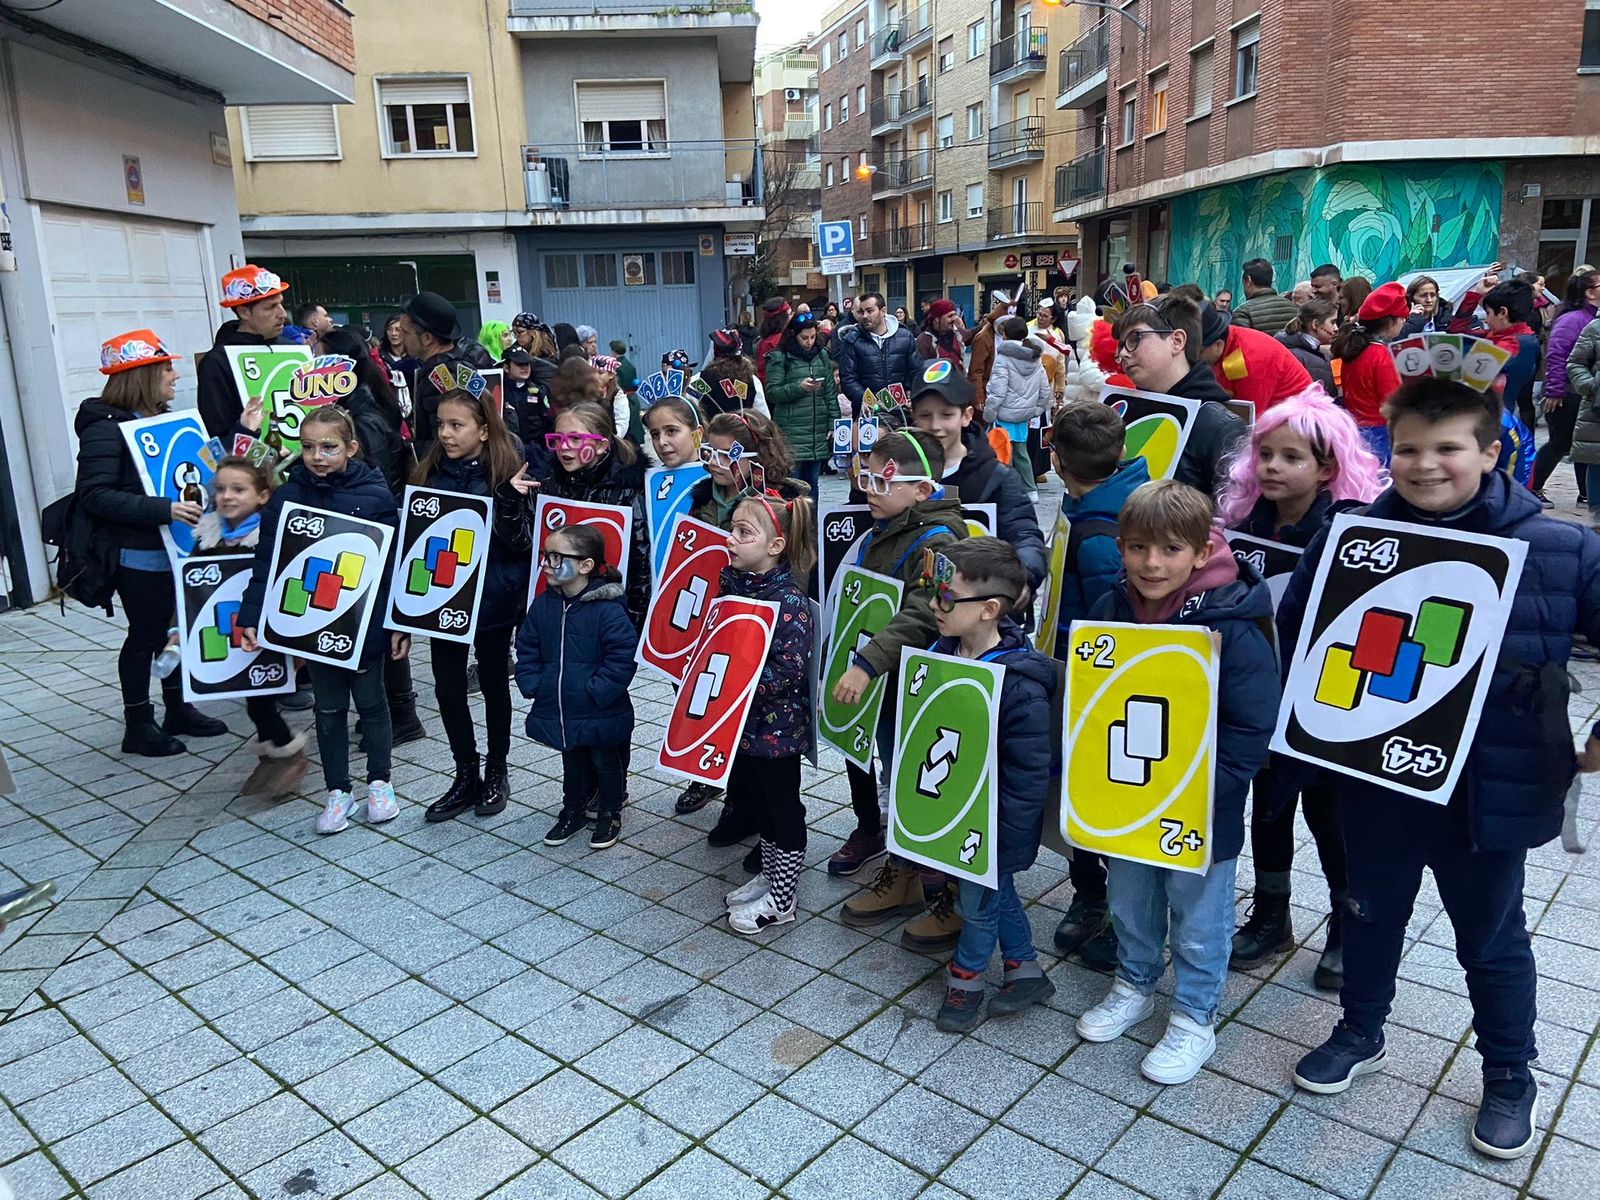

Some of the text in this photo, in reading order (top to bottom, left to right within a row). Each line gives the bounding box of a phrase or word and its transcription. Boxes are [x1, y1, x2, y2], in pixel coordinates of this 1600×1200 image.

[825, 225, 846, 253] P
[243, 356, 262, 381] 5
[289, 370, 358, 401] UNO
[140, 432, 161, 457] 8
[863, 427, 873, 440] 4
[413, 499, 438, 516] +4
[290, 518, 322, 537] +4
[677, 529, 697, 551] +2
[829, 518, 854, 540] +4
[1343, 539, 1397, 571] +4
[188, 565, 220, 585] +4
[845, 580, 862, 606] +2
[441, 610, 466, 628] +4
[320, 632, 351, 651] +4
[1075, 634, 1116, 669] +2
[251, 665, 282, 685] +4
[853, 724, 870, 752] +2
[698, 743, 725, 771] +2
[1384, 738, 1444, 775] +4
[1159, 818, 1203, 856] +2
